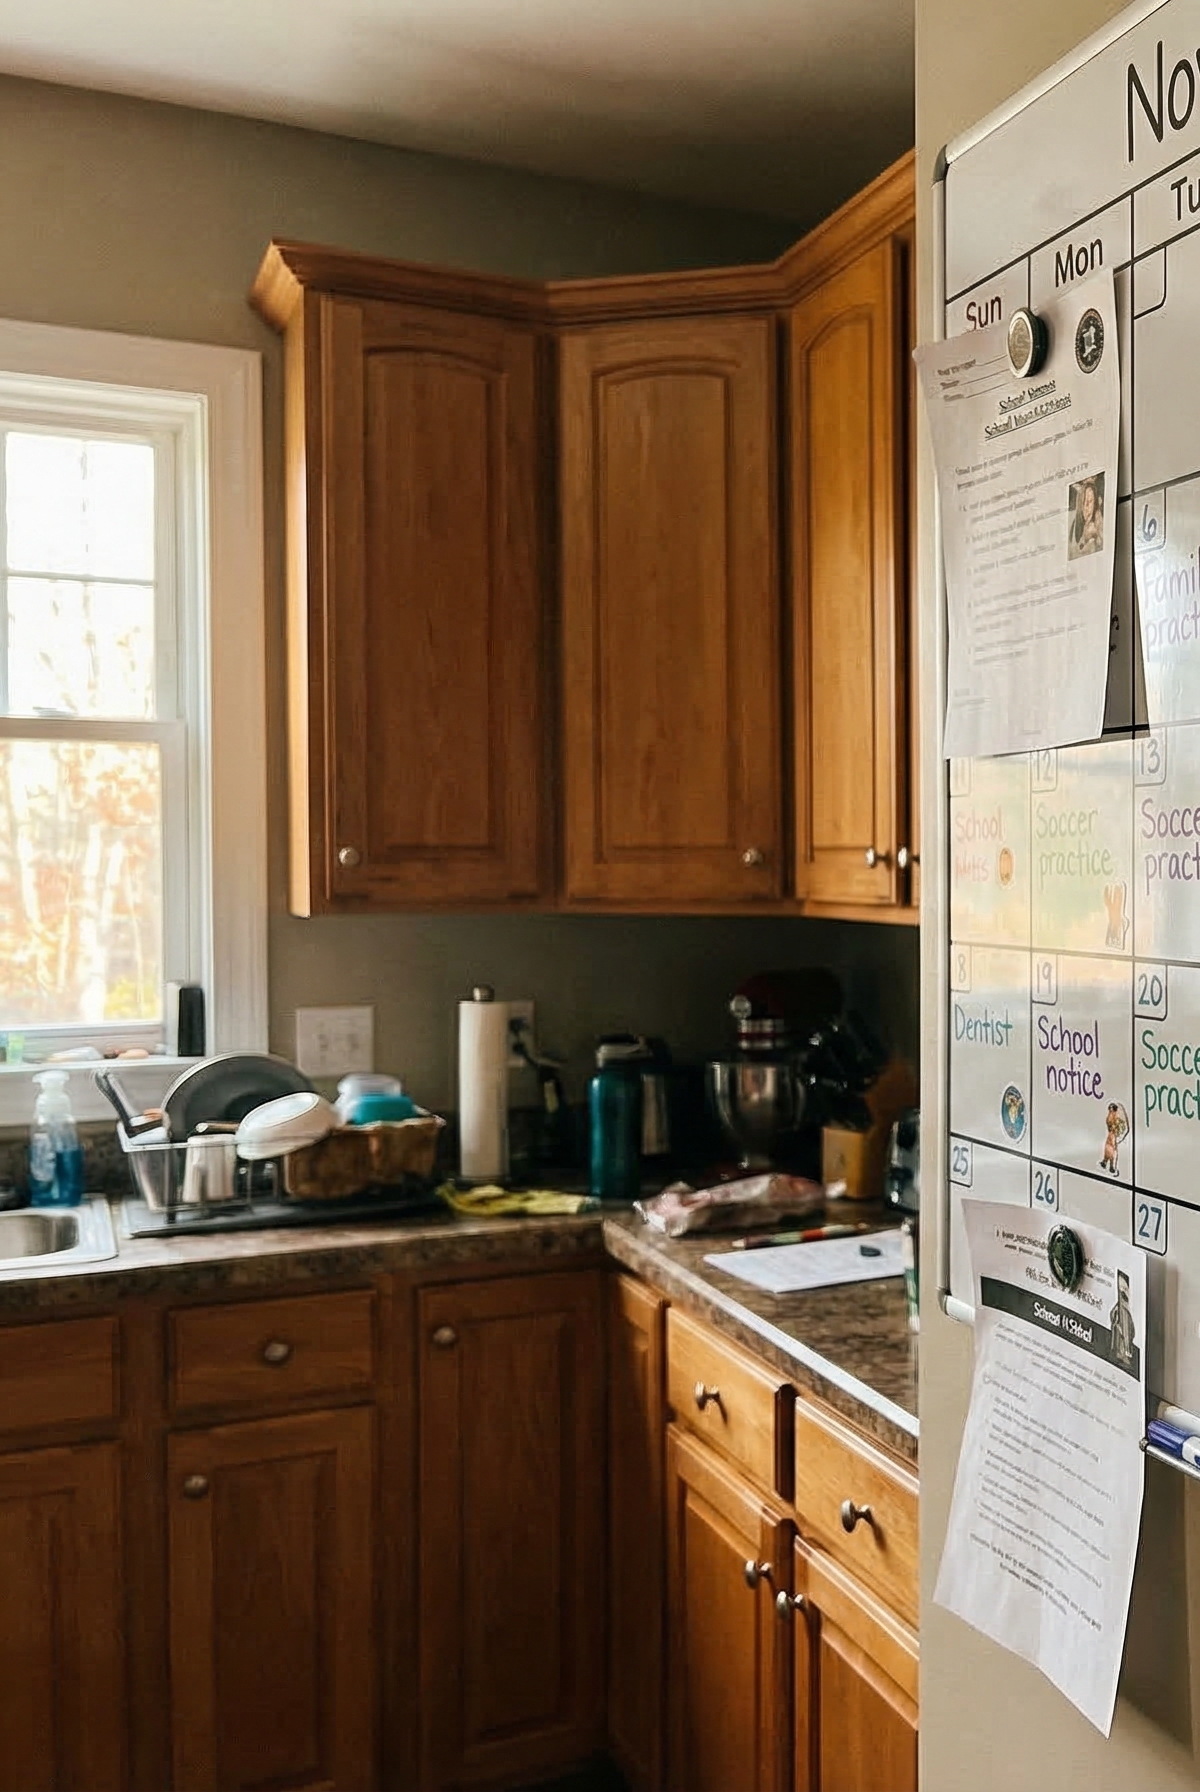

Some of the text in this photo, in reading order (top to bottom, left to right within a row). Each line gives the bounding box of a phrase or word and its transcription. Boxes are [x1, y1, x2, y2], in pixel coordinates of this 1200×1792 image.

[1055, 239, 1103, 288] Mon
[966, 296, 1002, 330] Sun
[1142, 504, 1157, 542] 6
[1036, 750, 1054, 782] 12
[1139, 738, 1161, 776] 13
[1035, 801, 1099, 840] Soccer
[1039, 842, 1114, 891] practice
[1037, 962, 1052, 994] 19
[1139, 973, 1162, 1007] 20
[955, 1004, 1013, 1047] Dentist
[1038, 1014, 1099, 1059] School
[1047, 1057, 1104, 1100] notice
[953, 1145, 968, 1176] 25
[1034, 1171, 1055, 1205] 26
[1138, 1203, 1163, 1242] 27
